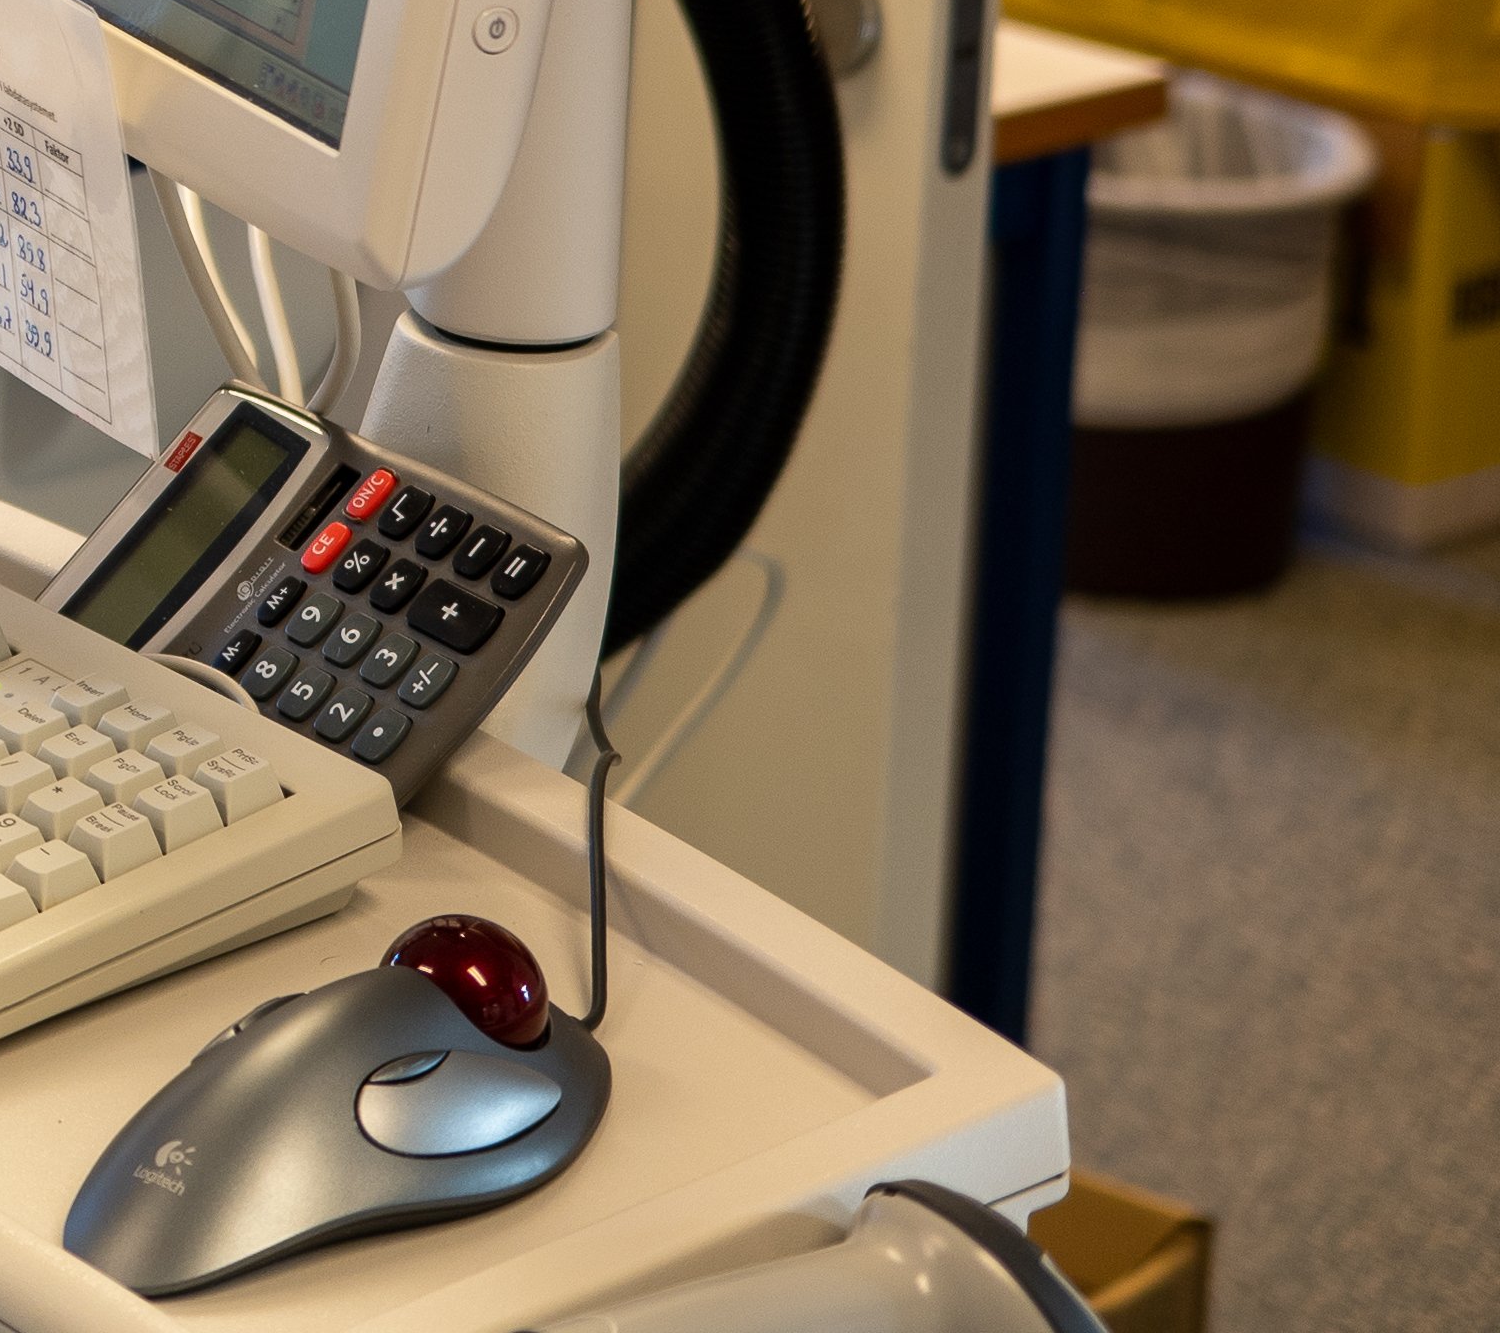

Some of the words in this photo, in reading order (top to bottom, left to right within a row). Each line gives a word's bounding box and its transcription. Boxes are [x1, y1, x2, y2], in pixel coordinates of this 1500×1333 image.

[44, 139, 70, 164] Faktor
[352, 475, 385, 509] ON/C
[311, 533, 335, 555] CE
[223, 595, 256, 634] Electronic
[255, 561, 287, 598] Calculator
[266, 586, 289, 610] M+
[301, 606, 321, 623] 9
[341, 627, 360, 644] 6
[221, 641, 242, 662] M-
[375, 648, 398, 667] 3
[255, 660, 277, 679] 8
[412, 662, 440, 693] +/-
[75, 679, 105, 697] Insert
[290, 683, 314, 701] 5
[17, 706, 47, 724] Delete
[123, 704, 153, 722] Home
[328, 703, 355, 723] 2
[63, 731, 88, 747] End
[171, 729, 200, 747] PgUp
[112, 757, 141, 774] PgDn
[230, 747, 260, 766] PrtSc
[153, 784, 179, 801] Lock
[166, 778, 197, 797] Scroll
[111, 803, 140, 822] Pause
[83, 814, 115, 833] Break
[132, 1165, 186, 1197] Logitech
